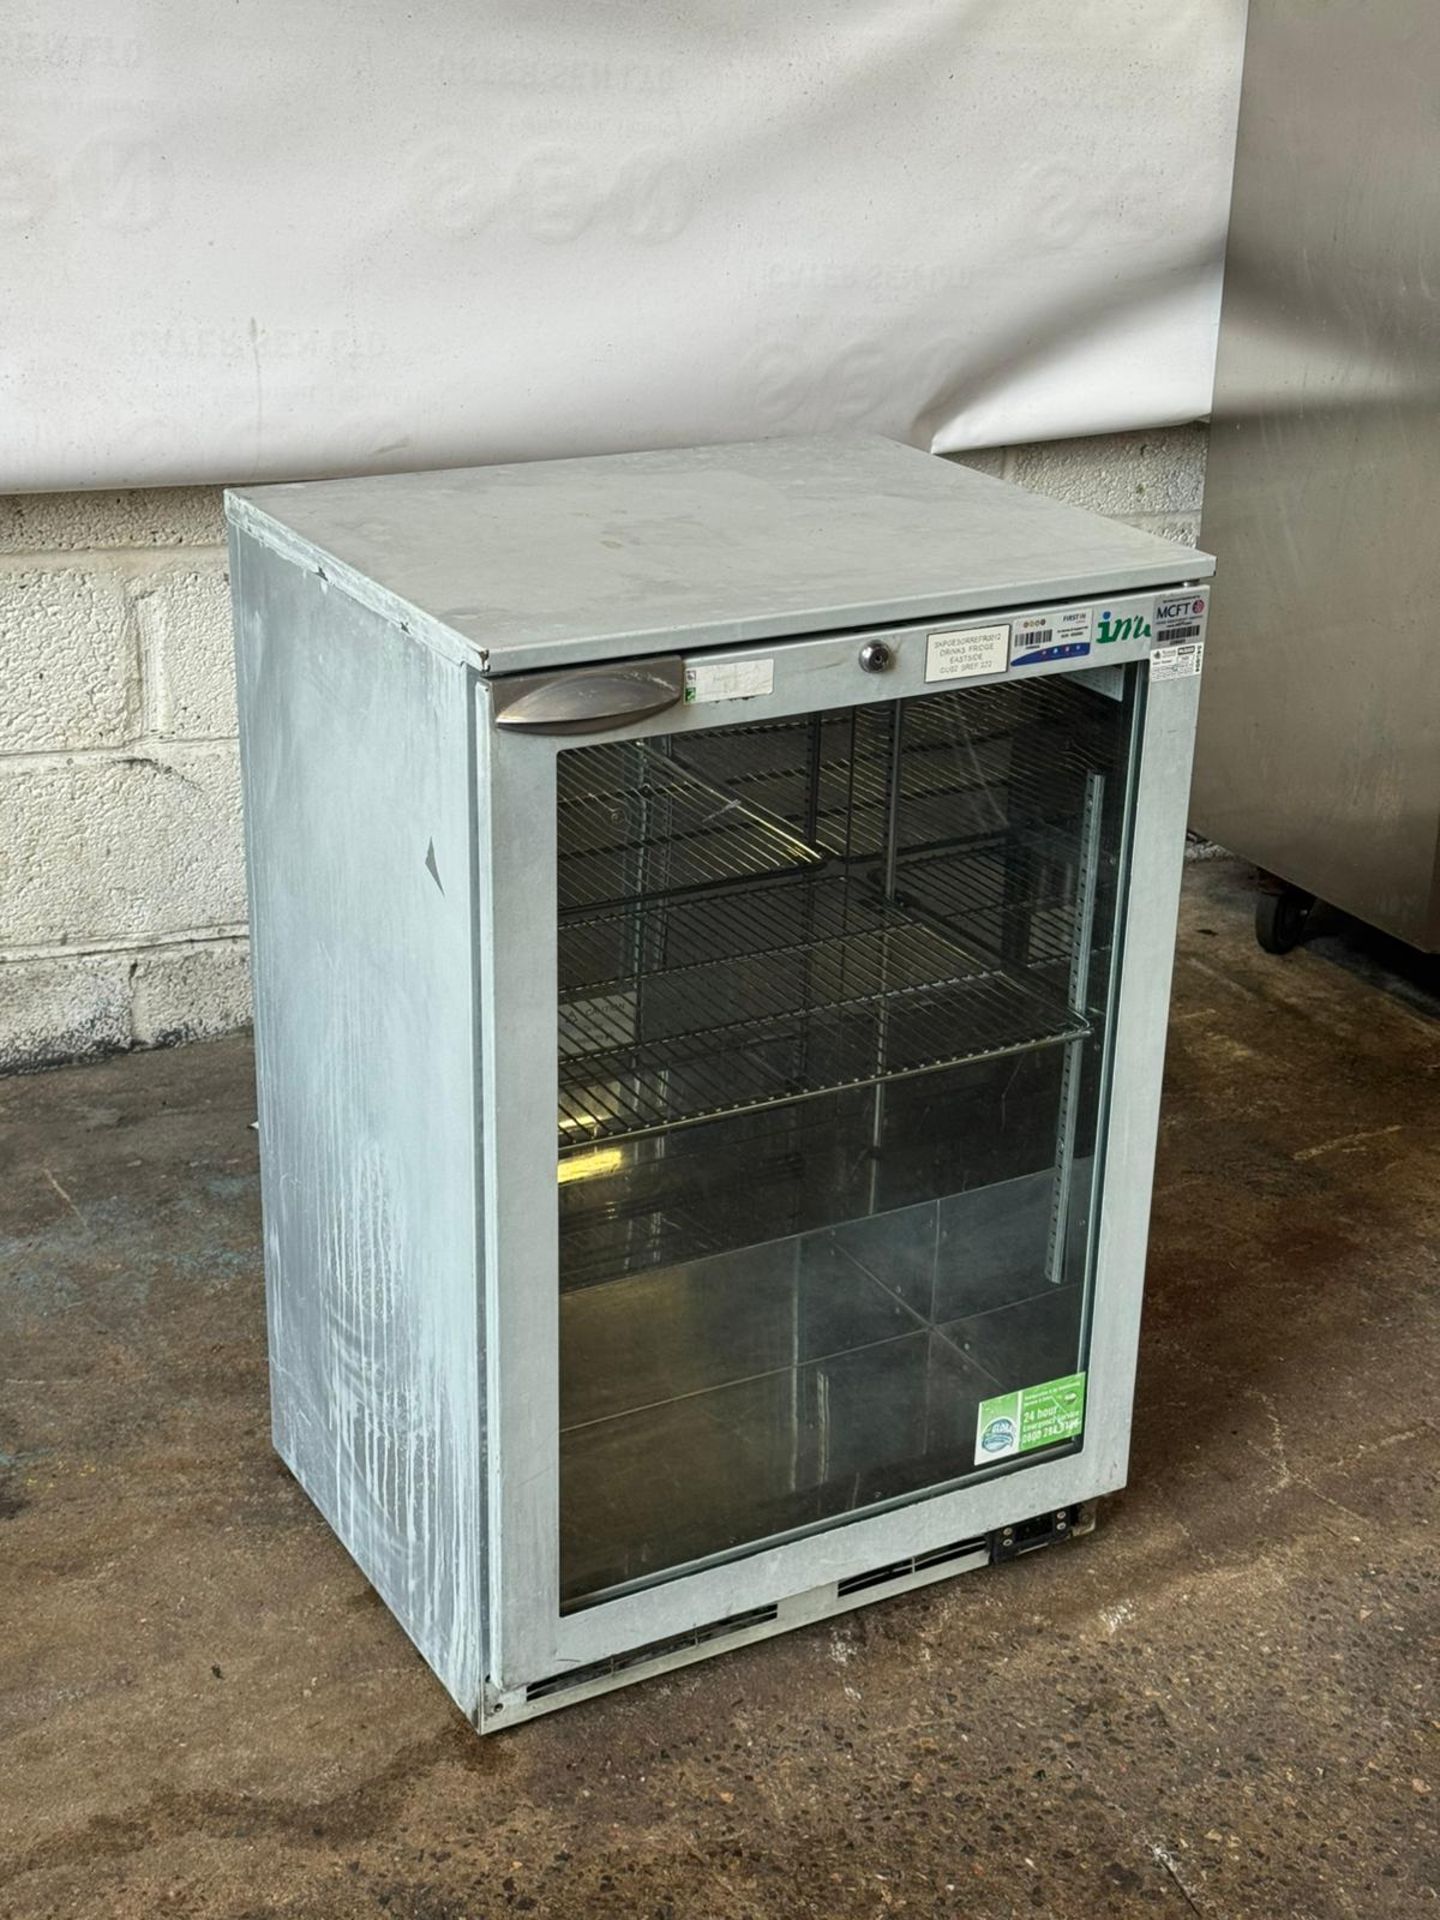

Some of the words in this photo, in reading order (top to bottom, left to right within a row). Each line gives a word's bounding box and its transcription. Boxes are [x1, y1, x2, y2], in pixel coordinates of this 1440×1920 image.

[1063, 613, 1079, 623] FIRST
[1156, 602, 1191, 620] MCFT
[939, 647, 966, 657] DRINKS
[968, 642, 995, 653] FRIDGE
[949, 652, 984, 665] EASTSIDE
[1023, 1410, 1035, 1423] 24
[1037, 1406, 1058, 1419] hour
